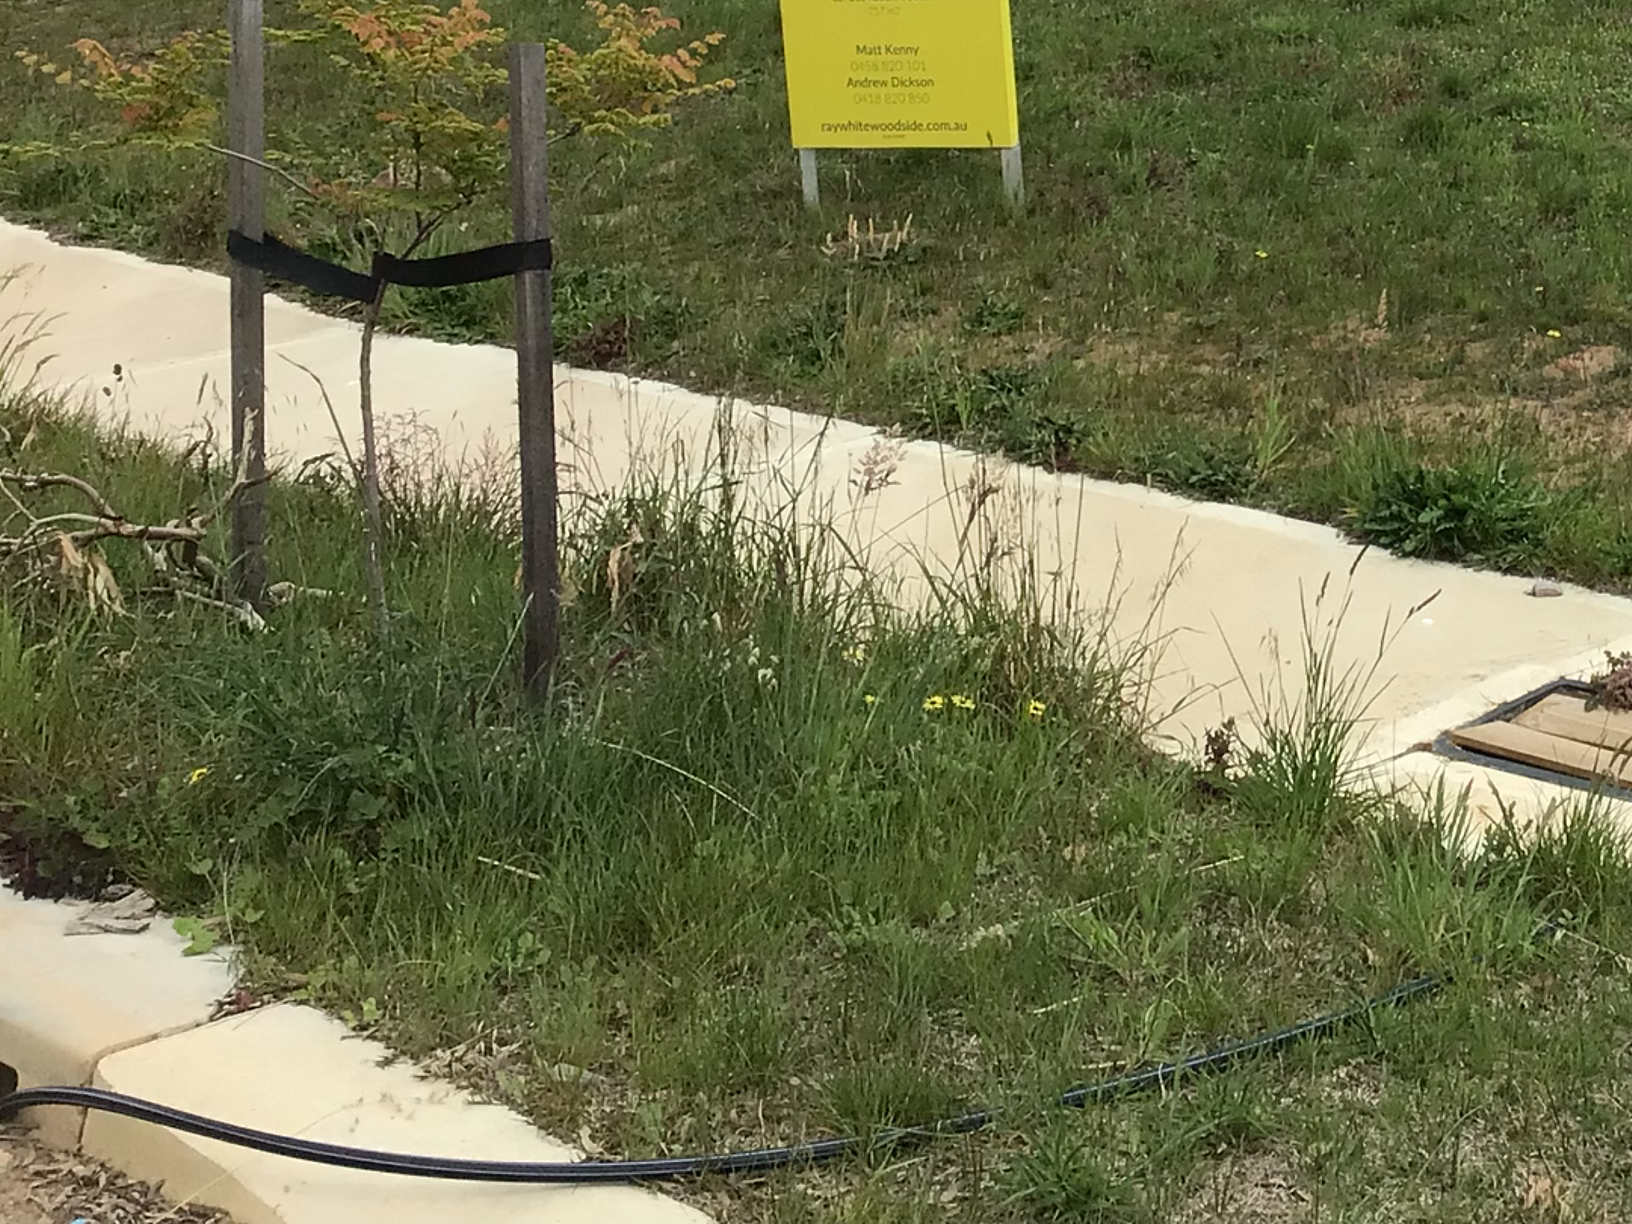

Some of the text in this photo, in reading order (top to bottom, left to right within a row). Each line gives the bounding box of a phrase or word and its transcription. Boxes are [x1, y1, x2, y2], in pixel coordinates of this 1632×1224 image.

[856, 44, 919, 57] Matt Kenny
[846, 76, 934, 88] Andrew Dickson
[821, 119, 968, 133] raywhitewoodside.com.au
